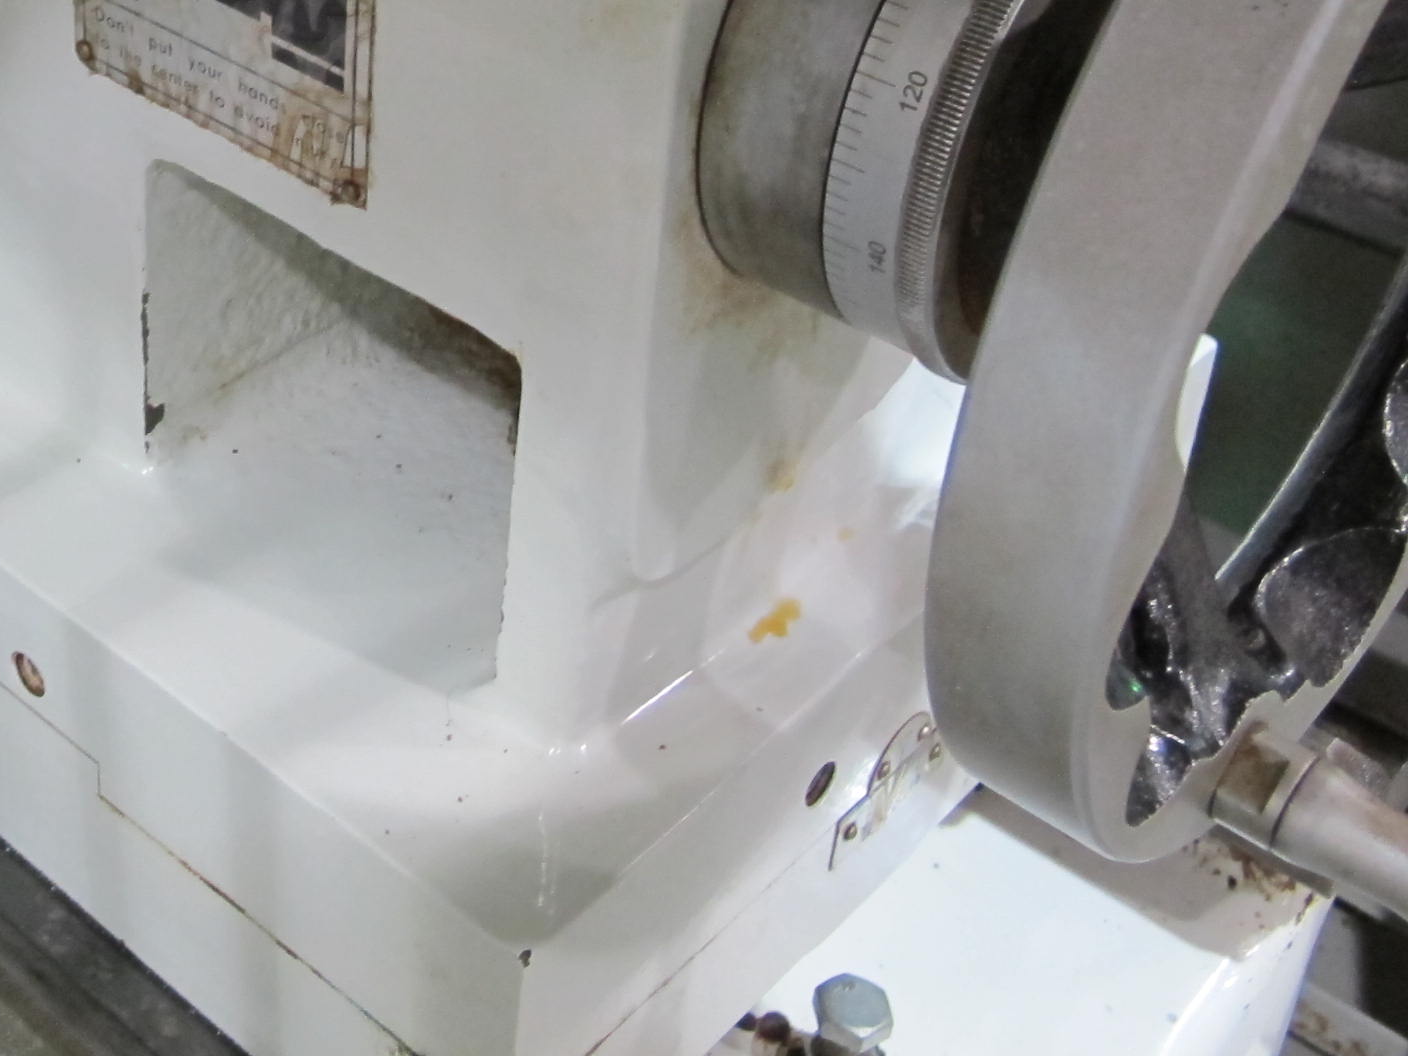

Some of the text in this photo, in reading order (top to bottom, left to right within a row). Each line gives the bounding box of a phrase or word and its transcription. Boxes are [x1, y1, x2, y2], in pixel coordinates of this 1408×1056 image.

[148, 37, 173, 56] put
[189, 56, 223, 81] your
[210, 89, 225, 109] to
[898, 70, 929, 113] 120
[867, 240, 887, 274] 140
